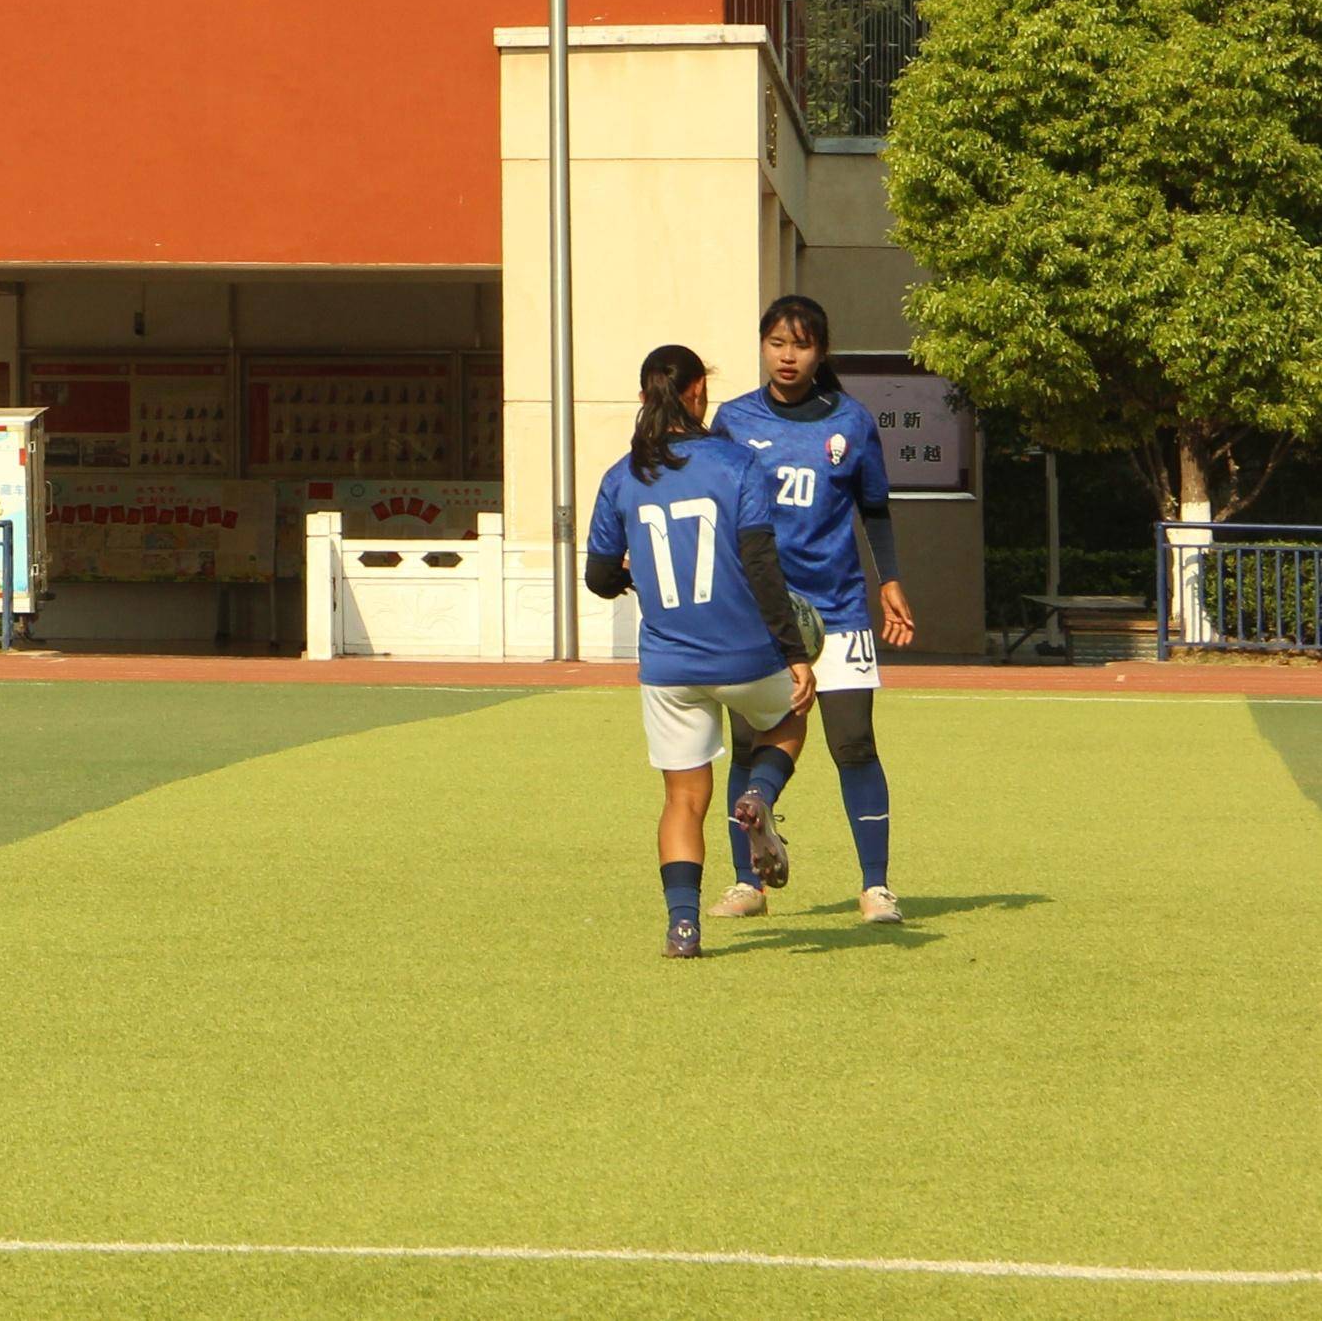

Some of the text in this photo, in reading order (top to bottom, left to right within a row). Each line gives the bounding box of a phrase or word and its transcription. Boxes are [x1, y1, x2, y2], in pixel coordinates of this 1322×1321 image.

[878, 411, 921, 429] 创新
[899, 445, 942, 462] 卓越
[776, 466, 816, 508] 20
[638, 497, 718, 610] 17
[845, 629, 875, 663] 20
